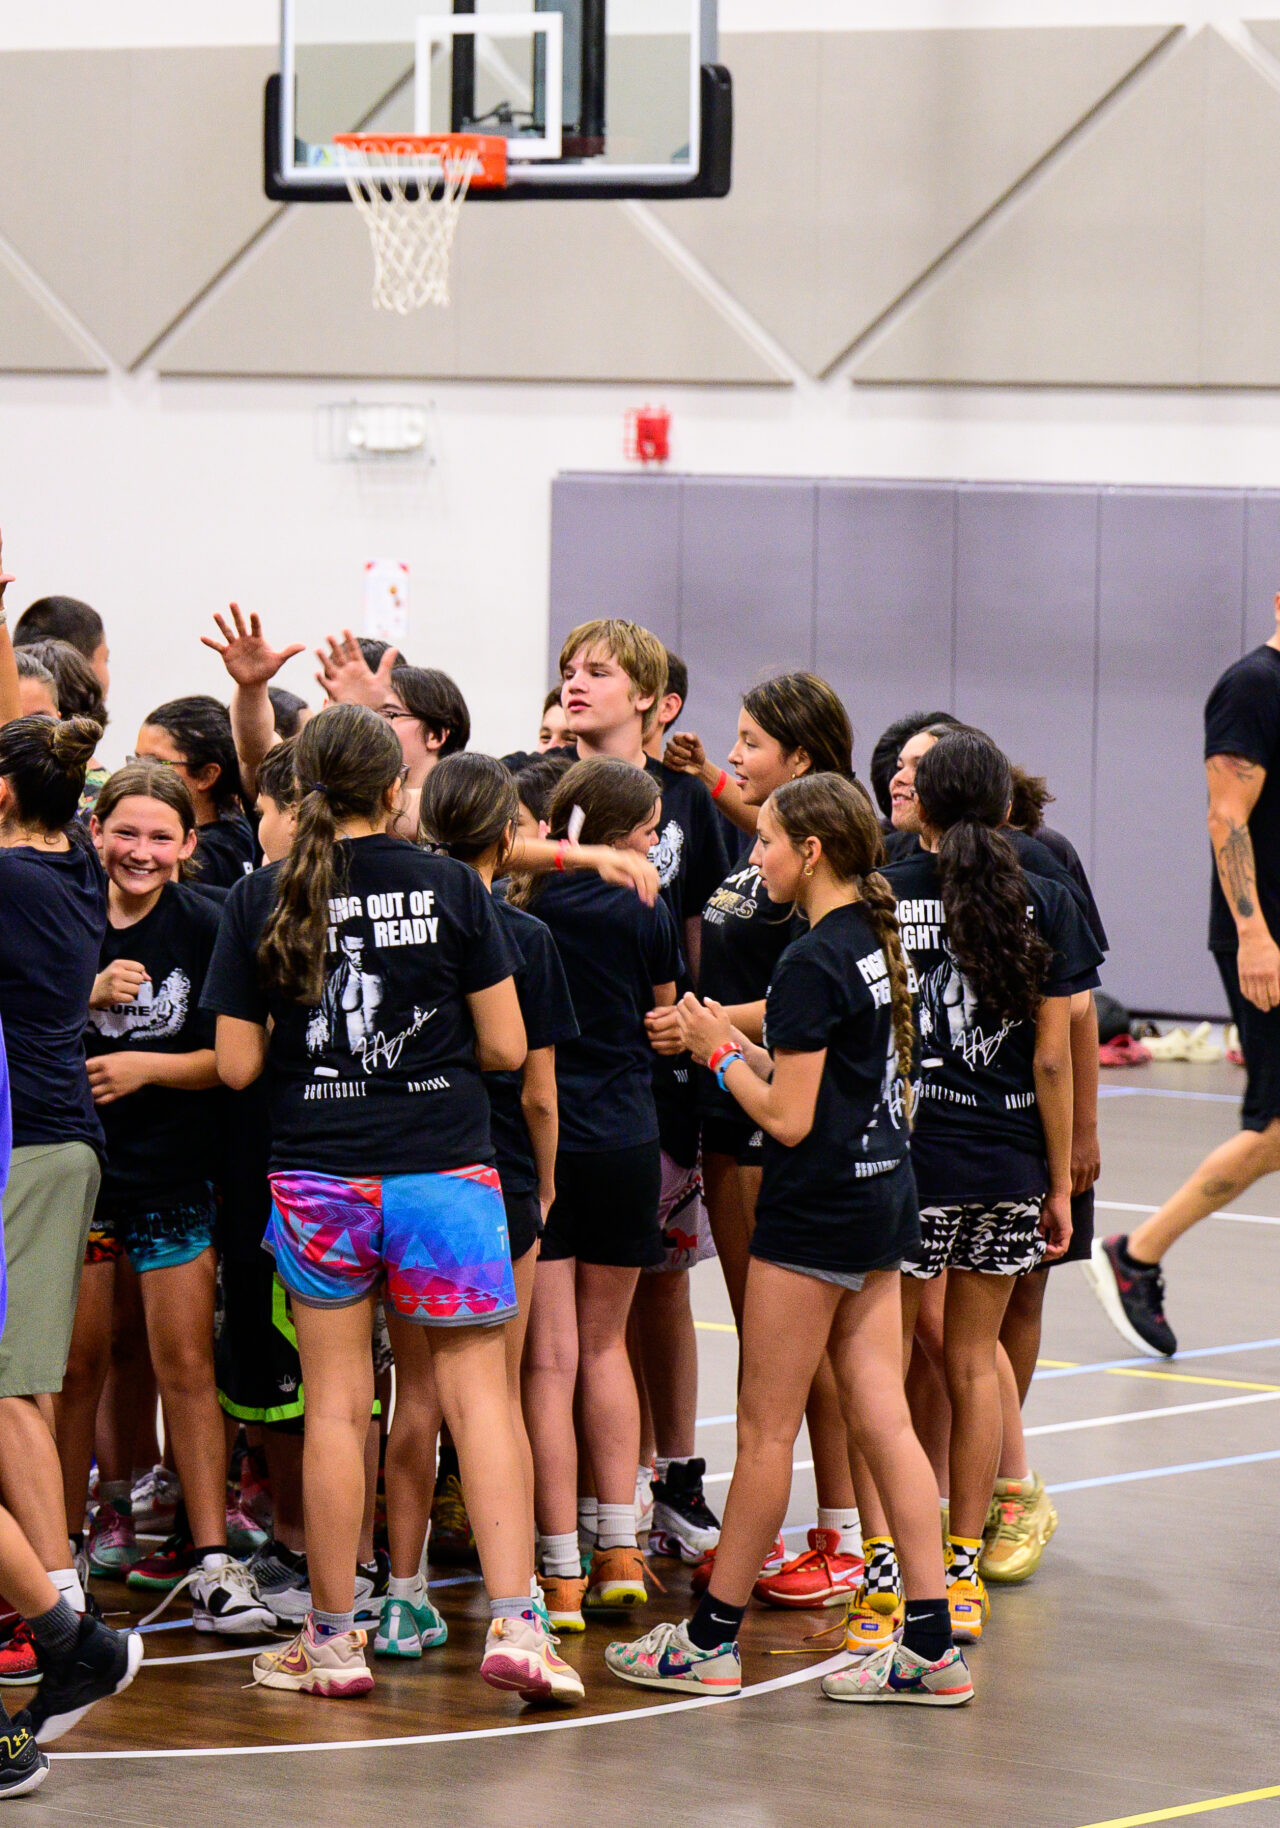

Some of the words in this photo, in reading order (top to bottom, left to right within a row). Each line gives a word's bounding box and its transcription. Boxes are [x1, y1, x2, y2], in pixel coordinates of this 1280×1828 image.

[366, 892, 404, 919] OUT
[409, 890, 435, 916] OF
[373, 917, 439, 948] READY
[304, 1081, 367, 1100] SCOTTSDALE
